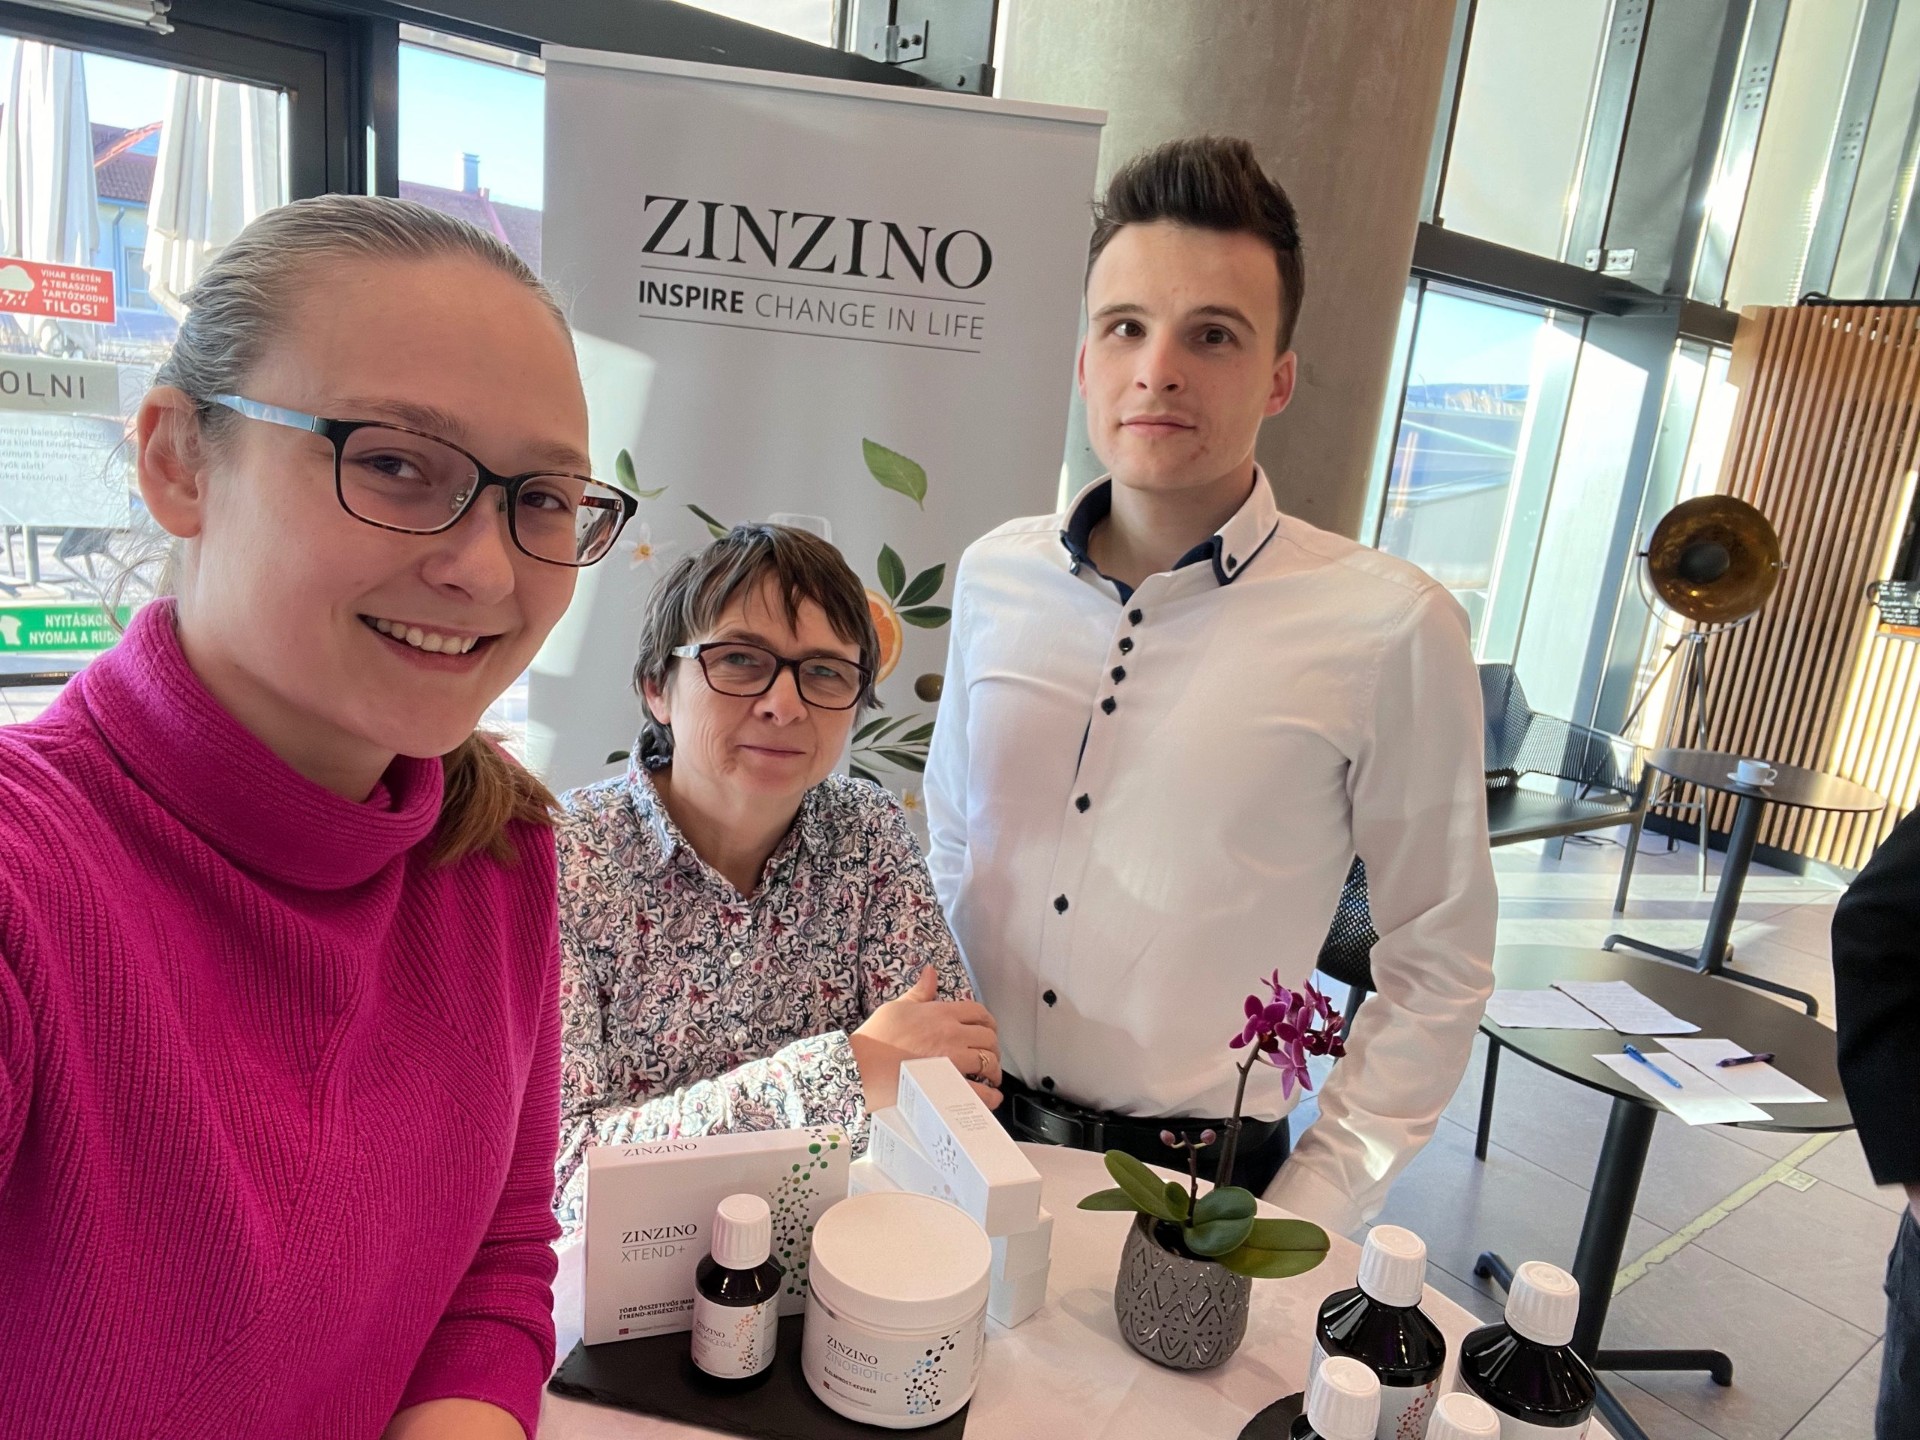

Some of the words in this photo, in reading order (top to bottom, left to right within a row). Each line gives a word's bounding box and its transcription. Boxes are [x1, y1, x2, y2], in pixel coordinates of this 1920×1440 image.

[641, 194, 993, 290] ZINZINO
[41, 269, 66, 280] VIHAR
[70, 272, 102, 283] ESETÉN
[41, 279, 49, 287] A
[51, 280, 98, 293] TERASZON
[41, 289, 109, 304] TARTÓZKODNI
[43, 299, 98, 317] TILOS!
[638, 280, 744, 314] INSPIRE
[755, 293, 876, 328] CHANGE
[889, 307, 915, 332] IN
[928, 312, 985, 340] LIFE
[0, 370, 85, 400] OLNI
[29, 630, 78, 645] NYOMJA
[80, 630, 89, 644] A
[622, 1143, 697, 1156] ZINZINO
[622, 1224, 697, 1243] ZINZINO
[621, 1245, 685, 1263] XTEND+
[827, 1334, 878, 1365] ZINZINO
[826, 1349, 899, 1383] ZINOBIOTIC+
